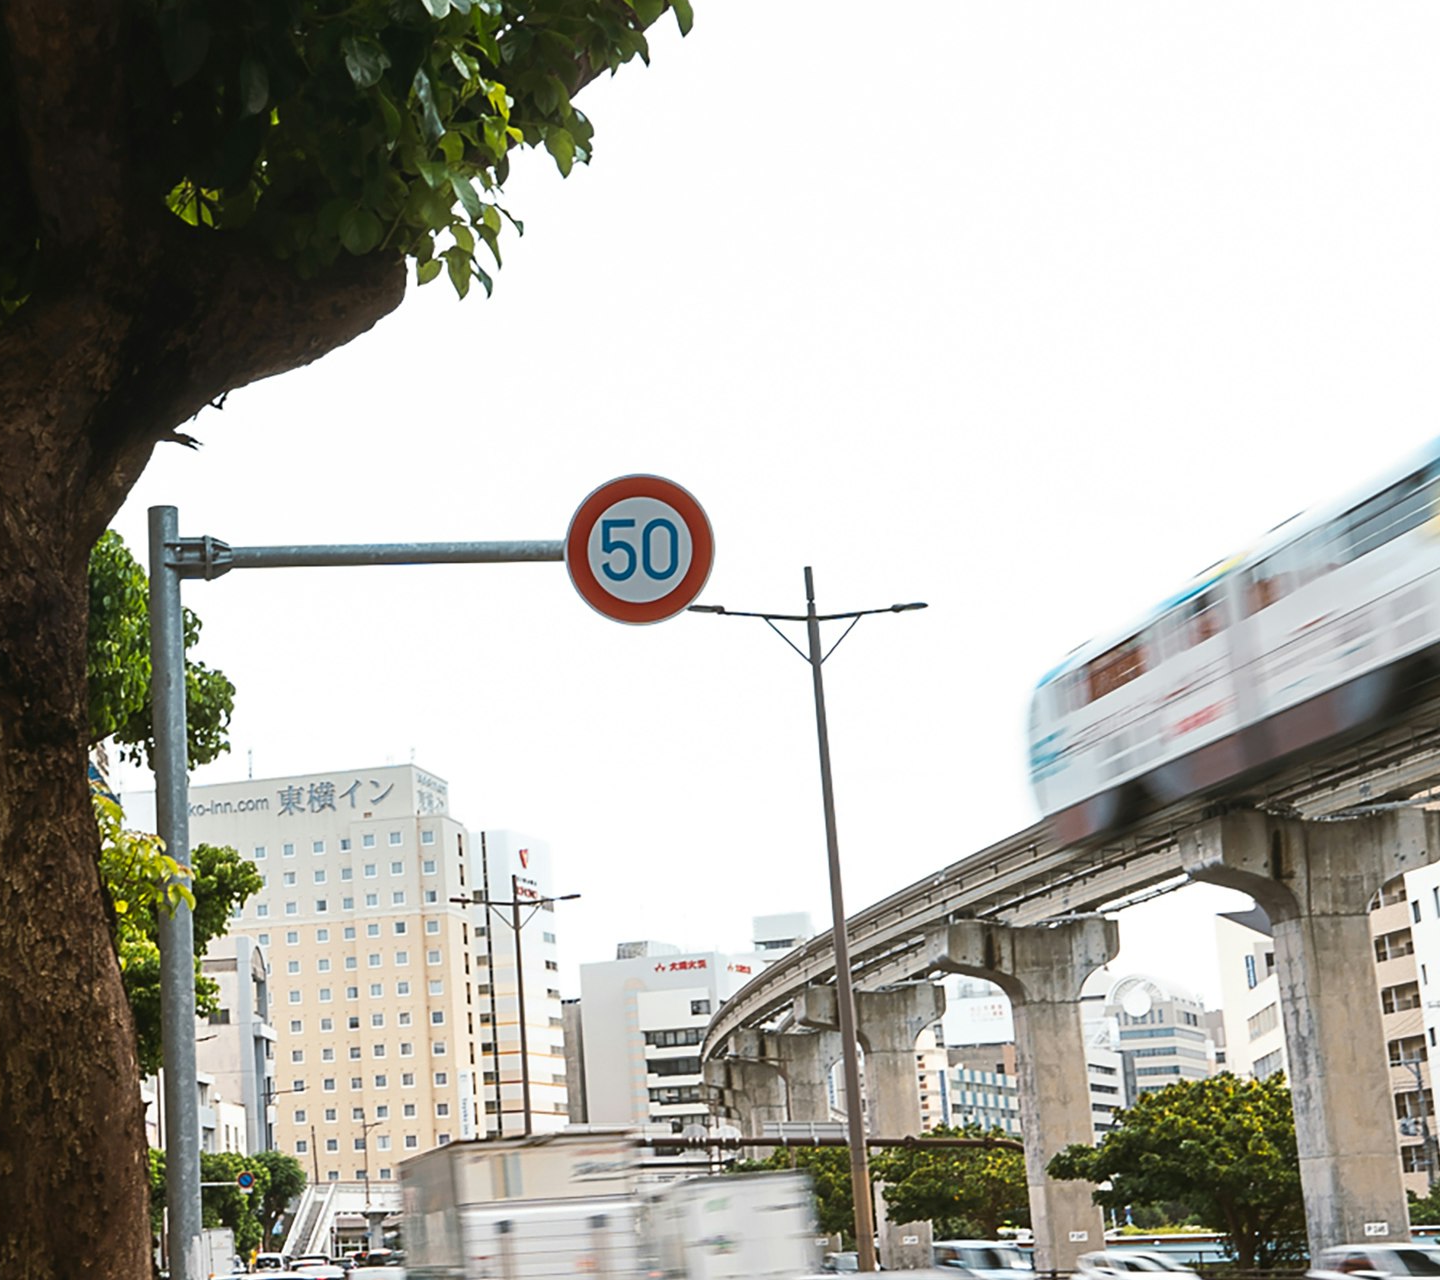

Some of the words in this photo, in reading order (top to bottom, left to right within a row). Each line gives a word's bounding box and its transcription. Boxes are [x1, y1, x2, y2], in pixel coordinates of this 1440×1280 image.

[601, 518, 679, 582] 50
[188, 796, 270, 817] ko-inn.com
[277, 778, 395, 817] 東横イン
